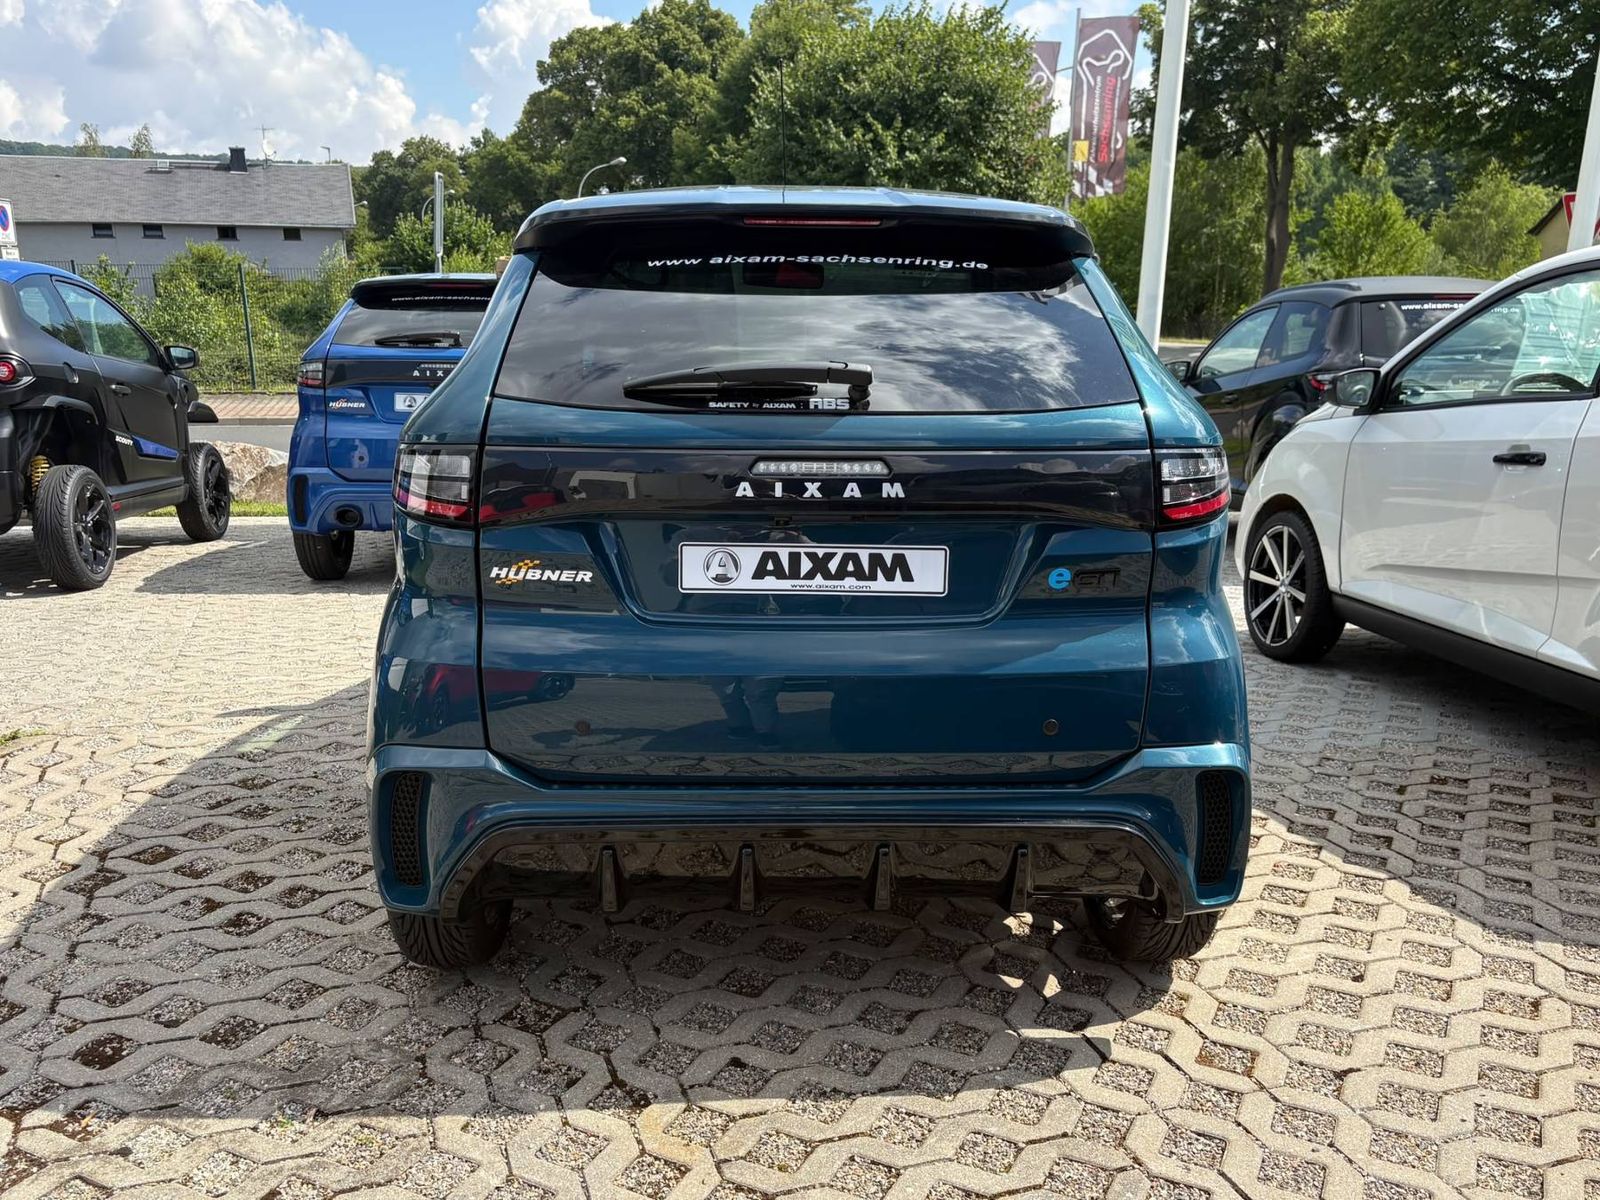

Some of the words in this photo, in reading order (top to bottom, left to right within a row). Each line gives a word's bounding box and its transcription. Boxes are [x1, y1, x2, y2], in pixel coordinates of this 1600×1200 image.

[412, 369, 445, 378] AIX
[708, 401, 749, 409] SAFETY
[809, 398, 850, 410] ABS
[735, 481, 905, 498] AIXAM
[489, 560, 594, 583] HÜBNER
[751, 551, 915, 583] AIXAM
[790, 583, 872, 591] www.aixam.com
